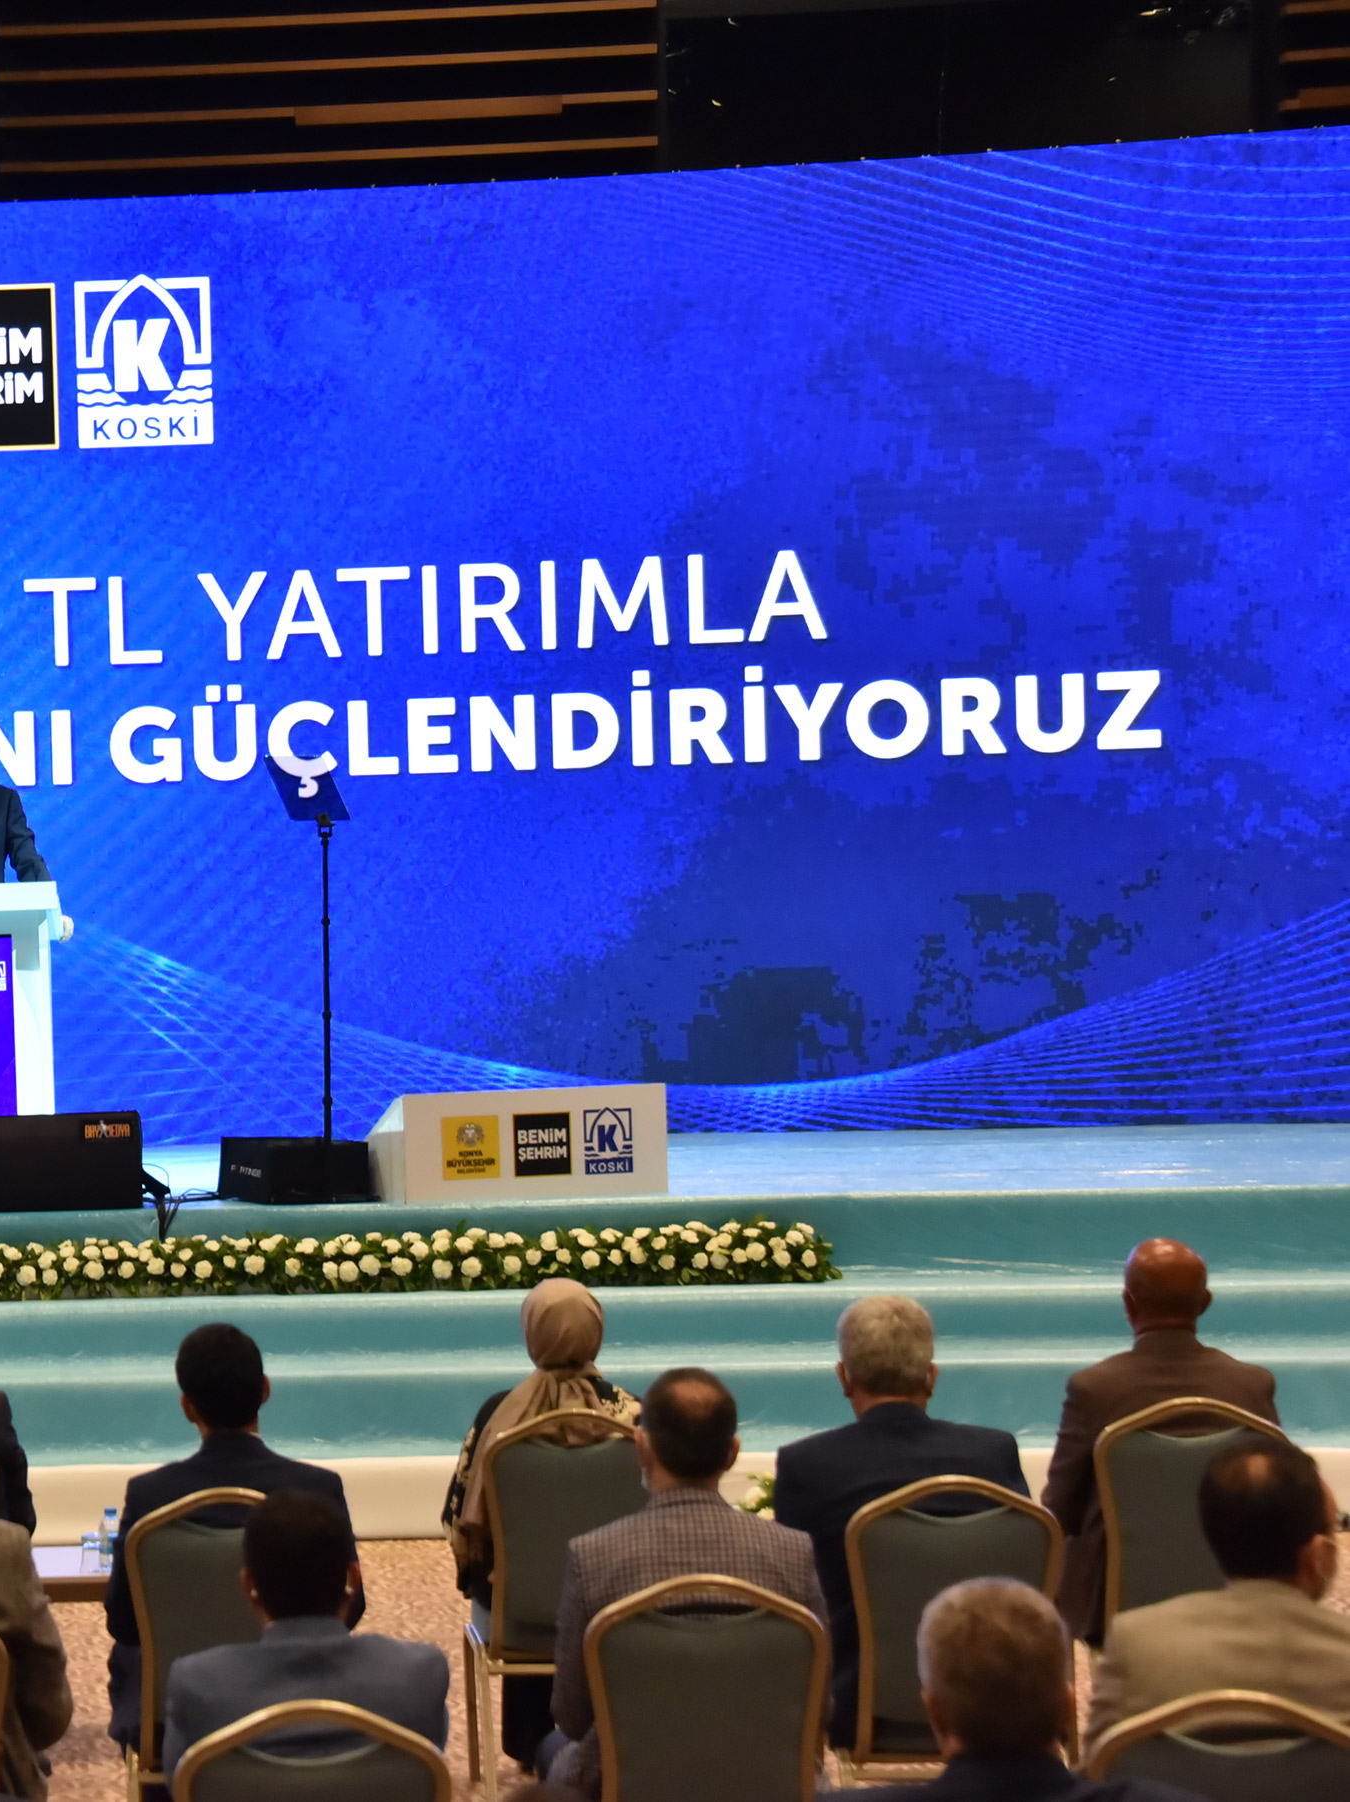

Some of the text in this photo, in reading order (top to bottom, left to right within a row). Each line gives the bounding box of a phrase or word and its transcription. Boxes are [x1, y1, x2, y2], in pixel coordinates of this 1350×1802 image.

[113, 318, 174, 392] K
[93, 408, 199, 440] KOSKİ
[23, 576, 163, 667] TL
[197, 549, 828, 661] YATIRIMLA
[109, 665, 1162, 798] GÜÇLENDİRİYORUZ
[517, 1127, 567, 1145] BENİM
[597, 1124, 618, 1152] K
[458, 1149, 483, 1158] KONYA
[518, 1145, 568, 1162] ŞEHRİM
[589, 1160, 629, 1173] KOSKİ
